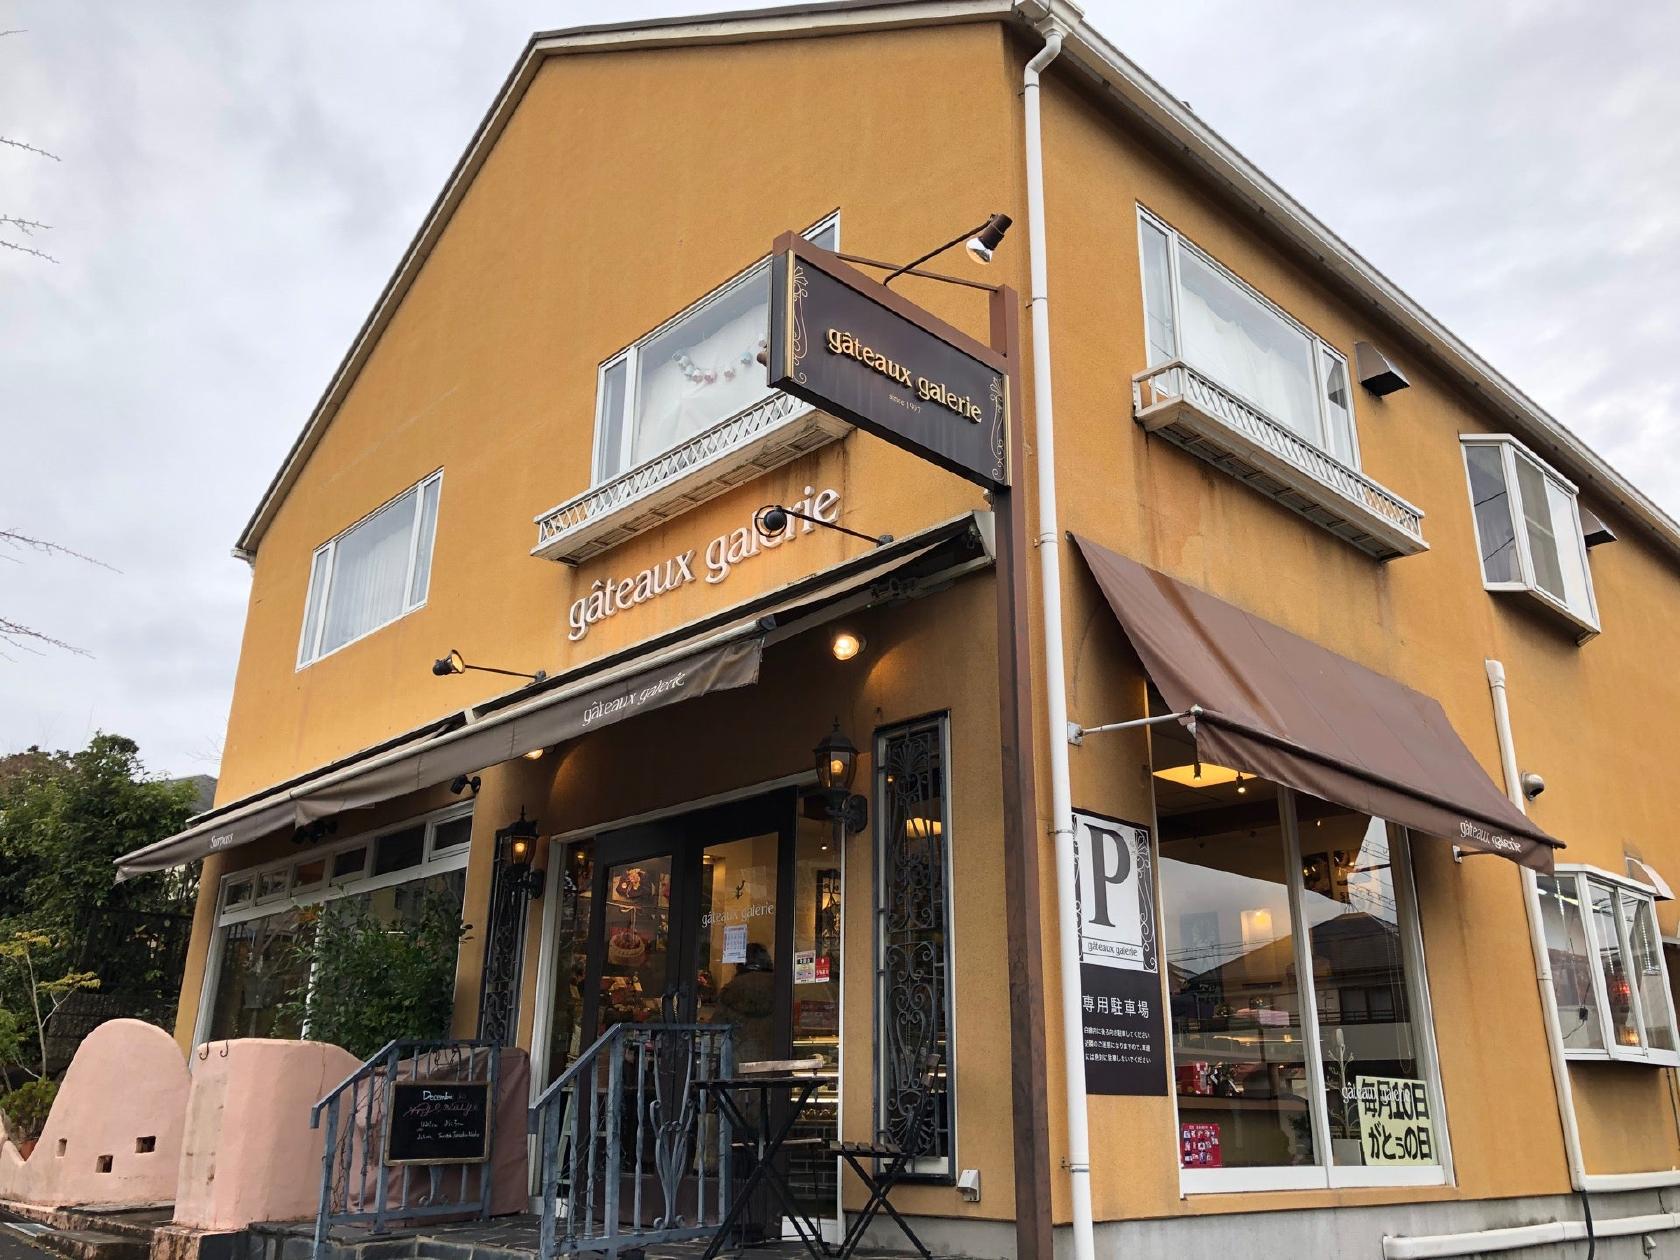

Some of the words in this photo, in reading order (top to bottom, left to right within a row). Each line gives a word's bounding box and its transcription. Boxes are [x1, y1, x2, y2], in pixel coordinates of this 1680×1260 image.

[825, 328, 912, 389] gâteaux
[915, 376, 983, 424] galerie
[567, 550, 696, 642] gâteaux
[582, 690, 636, 727] gâteaux
[637, 672, 688, 706] galerie
[1083, 823, 1131, 928] P
[741, 902, 775, 922] galerie
[1082, 994, 1149, 1019] 専用駐車場
[1361, 1078, 1430, 1120] 毎月10日
